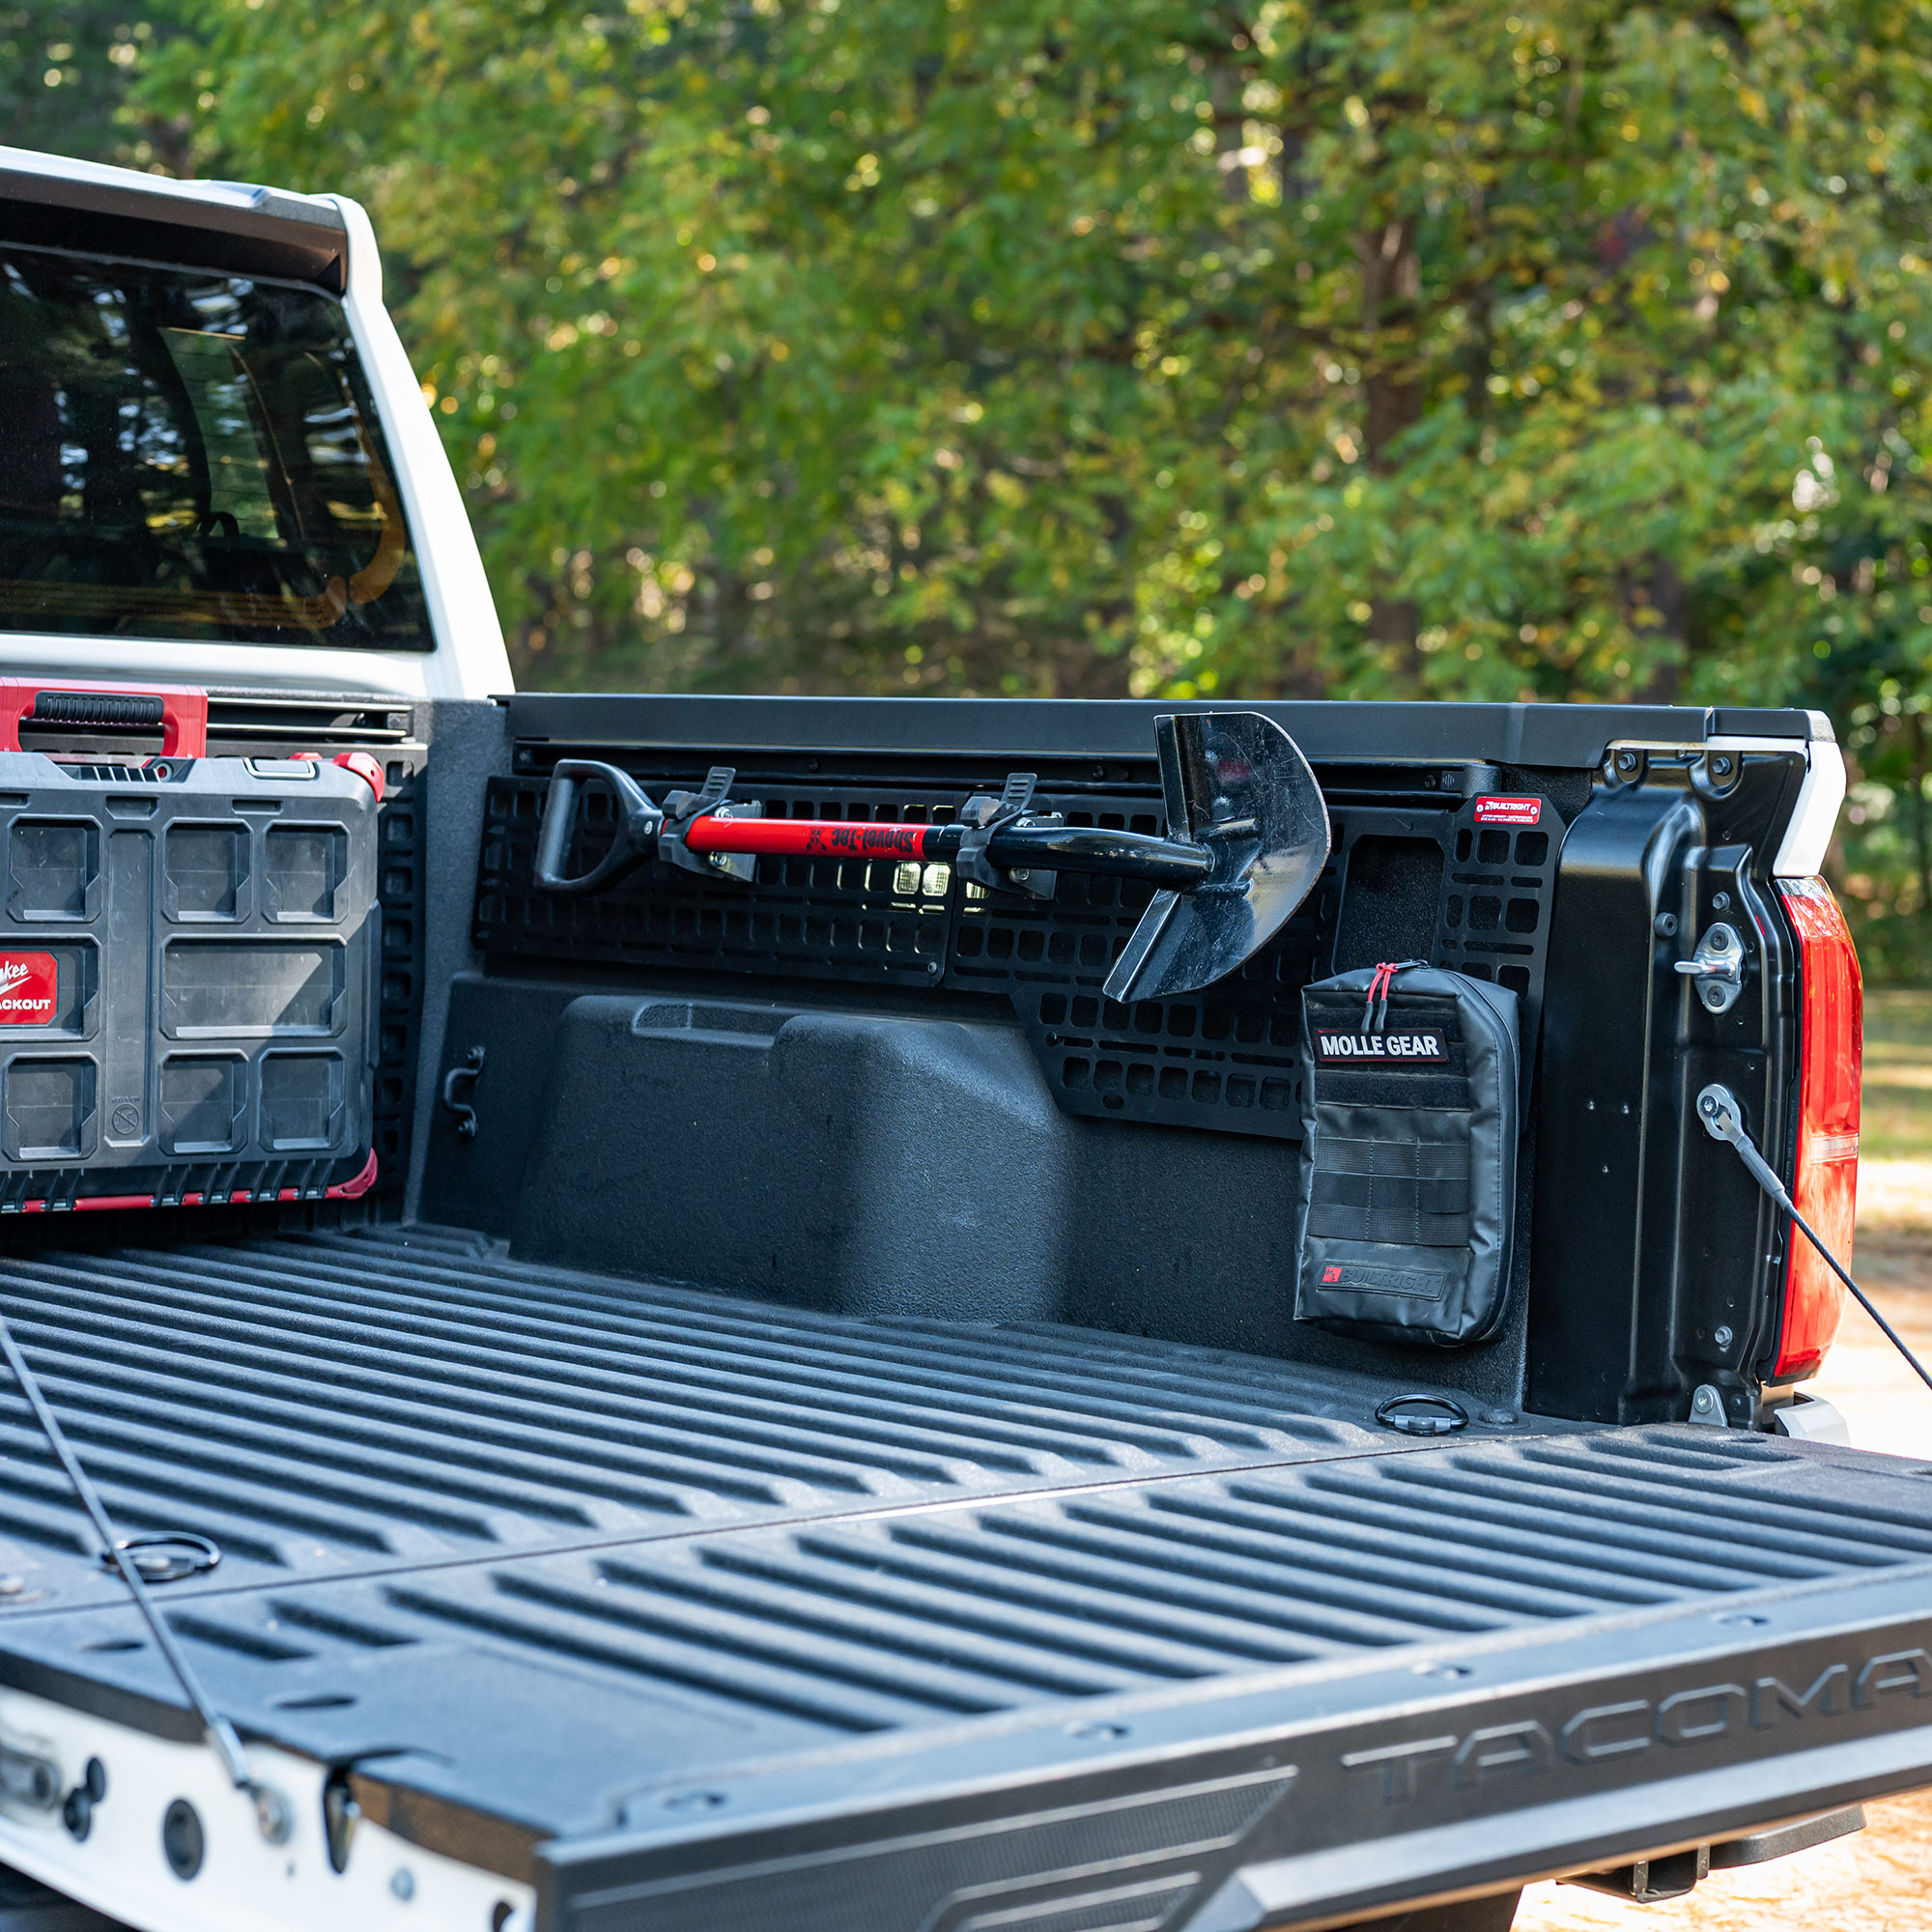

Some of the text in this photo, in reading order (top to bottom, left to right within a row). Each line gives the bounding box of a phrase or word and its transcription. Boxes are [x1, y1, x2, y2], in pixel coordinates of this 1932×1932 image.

[1492, 801, 1532, 811] BUILTRIGHT
[830, 828, 914, 853] Shovel-Tec
[0, 999, 51, 1010] CKOUT
[1320, 1034, 1440, 1057] MOLLE GEAR
[1339, 1269, 1440, 1293] BUILTRIGHT
[1341, 1647, 1932, 1805] TACOMA
